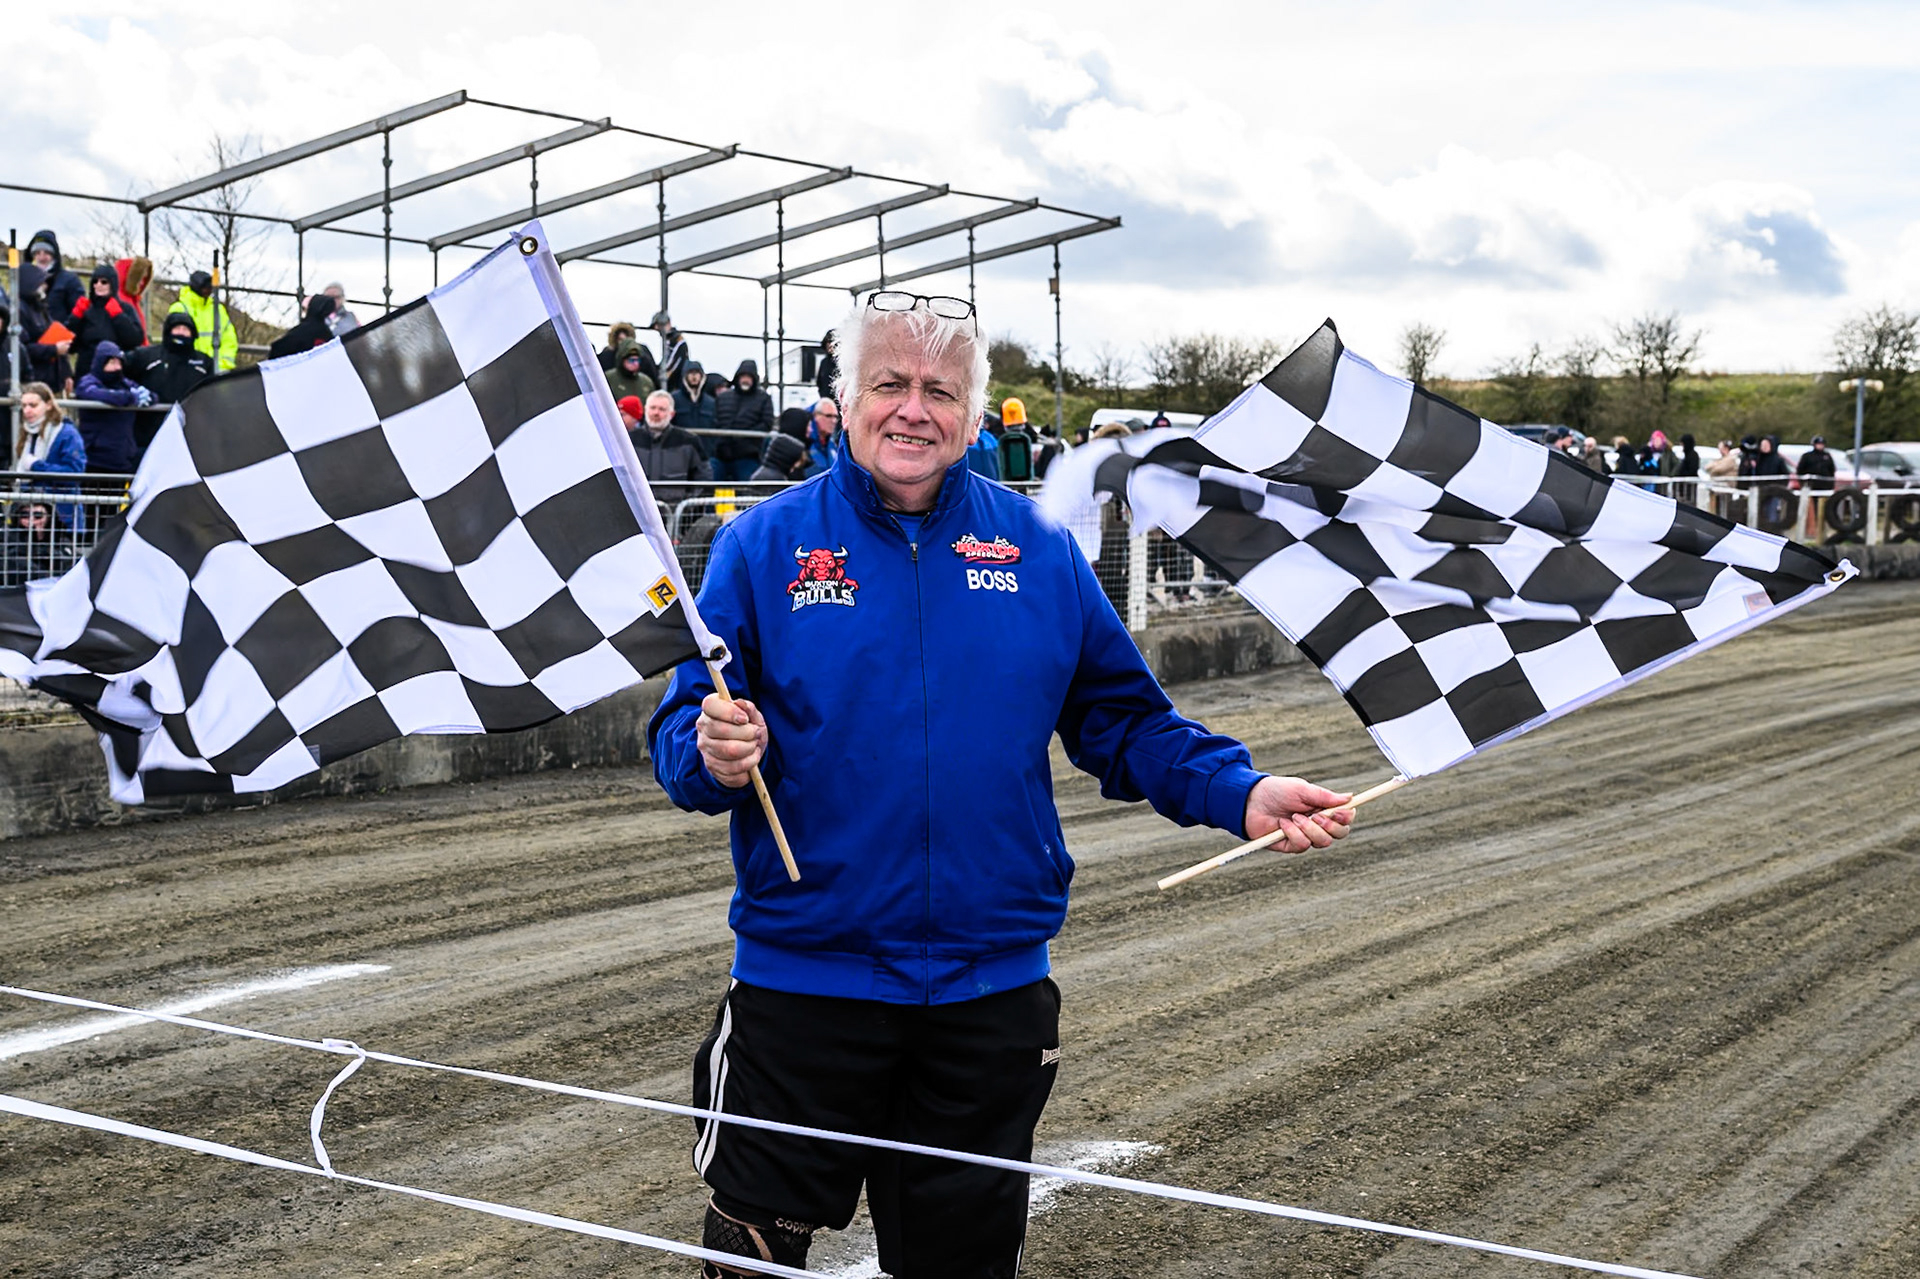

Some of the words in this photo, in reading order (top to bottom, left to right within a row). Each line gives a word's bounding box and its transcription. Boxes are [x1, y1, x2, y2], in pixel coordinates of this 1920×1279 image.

[956, 541, 1020, 557] BUXTON
[966, 568, 1019, 593] BOSS
[791, 589, 855, 612] BULLS
